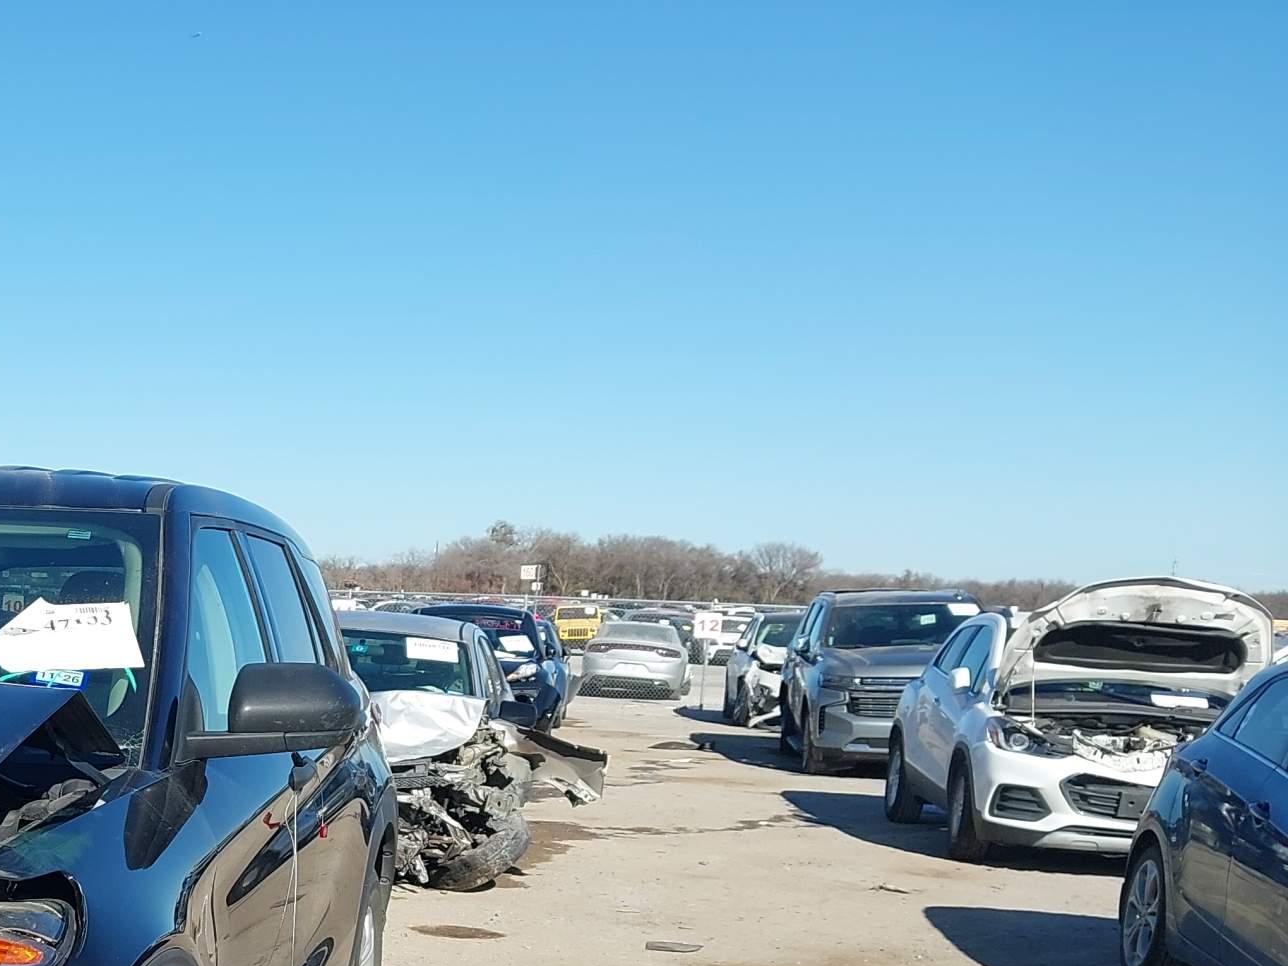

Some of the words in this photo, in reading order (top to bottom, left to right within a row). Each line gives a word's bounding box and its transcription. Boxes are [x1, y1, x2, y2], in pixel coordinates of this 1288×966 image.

[4, 600, 23, 612] 10
[698, 619, 719, 632] 12
[62, 674, 80, 684] 26
